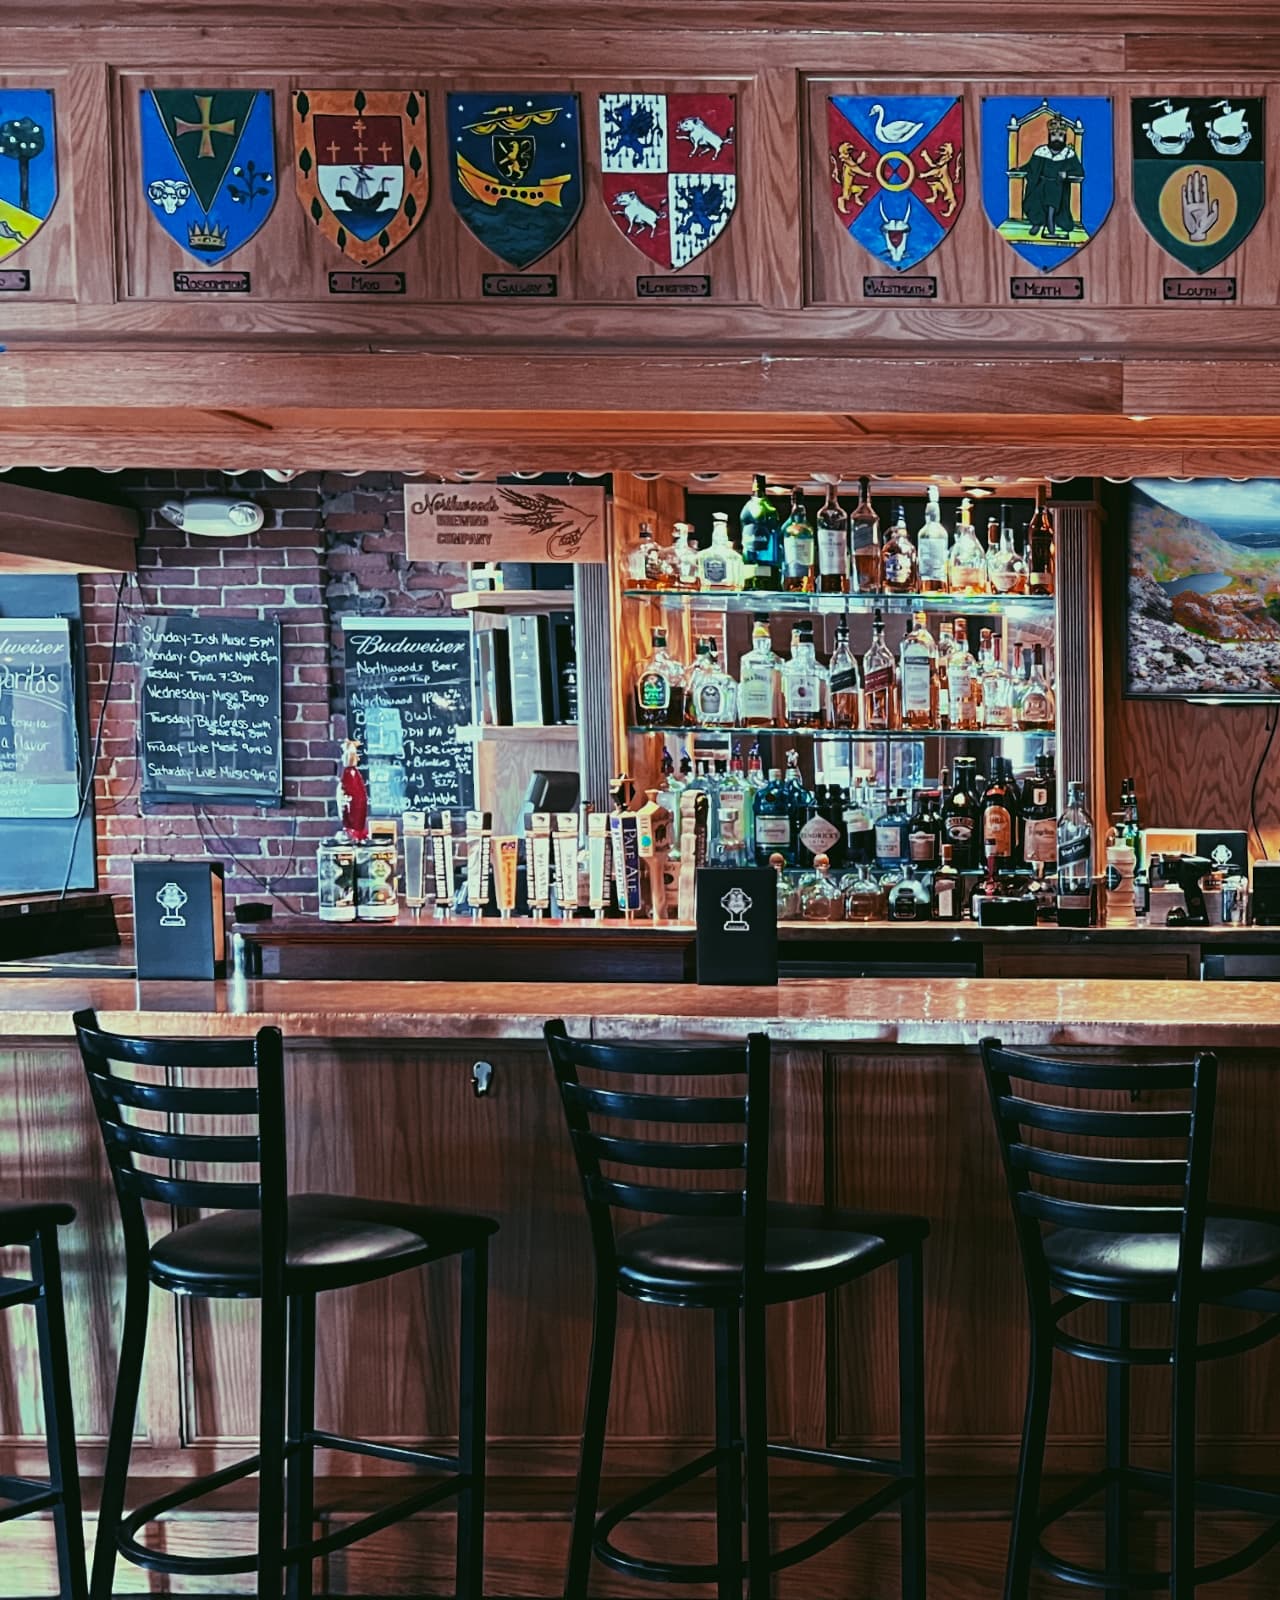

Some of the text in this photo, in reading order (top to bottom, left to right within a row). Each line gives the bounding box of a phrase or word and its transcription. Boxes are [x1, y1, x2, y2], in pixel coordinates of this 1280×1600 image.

[352, 277, 381, 290] MAYO
[497, 279, 542, 293] GALWAY
[1024, 282, 1061, 296] MEATH
[1178, 283, 1217, 296] LOUTH
[411, 493, 499, 515] Northwoods
[222, 633, 247, 646] Music
[350, 635, 466, 655] Budweiser
[189, 650, 217, 666] Open
[235, 650, 260, 667] Night
[356, 660, 459, 678] Northwoods Beer
[240, 690, 269, 707] Bingo
[195, 767, 217, 778] Live
[219, 767, 250, 779] Music
[623, 828, 640, 896] PALE ALE
